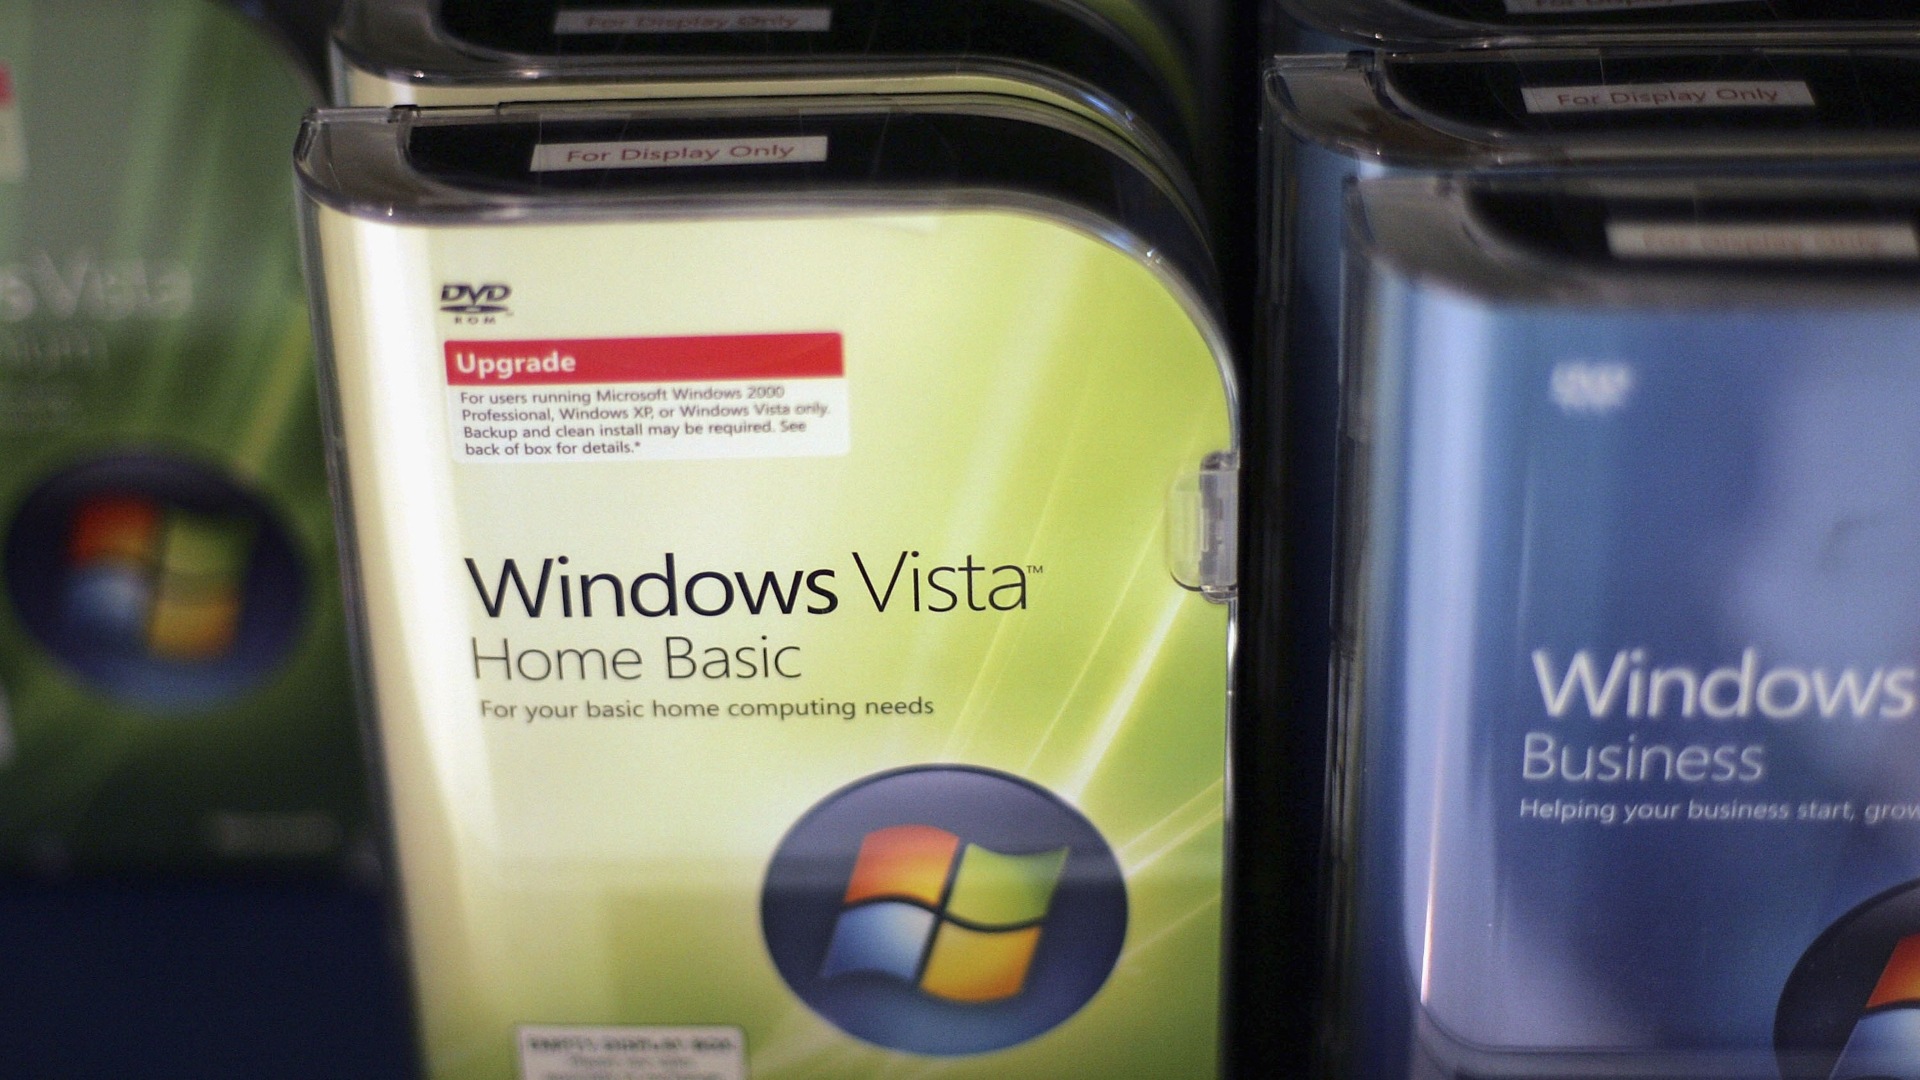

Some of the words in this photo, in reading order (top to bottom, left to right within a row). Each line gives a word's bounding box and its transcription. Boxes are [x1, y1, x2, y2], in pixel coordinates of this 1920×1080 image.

[1557, 93, 1598, 106] For
[1610, 89, 1707, 107] Display
[1716, 87, 1780, 103] Only
[567, 150, 611, 163] For
[621, 146, 721, 165] Display
[729, 144, 796, 161] Only
[441, 284, 511, 304] DVD
[456, 351, 576, 379] Upgrade
[460, 391, 484, 404] For
[489, 393, 527, 404] users
[532, 391, 591, 405] running
[596, 388, 667, 402] Microsoft
[672, 386, 742, 400] Windows
[748, 385, 785, 398] 2000
[462, 407, 555, 422] Professional,
[560, 406, 628, 420] Windows
[633, 406, 654, 420] XP,
[659, 406, 675, 417] or
[680, 403, 749, 417] Windows
[754, 403, 790, 416] Vista
[795, 401, 830, 418] only.
[464, 425, 518, 441] Backup
[523, 425, 550, 438] and
[556, 424, 595, 438] clean
[600, 423, 643, 436] install
[648, 425, 679, 438] may
[685, 422, 703, 435] be
[709, 420, 776, 436] required.
[781, 420, 807, 433] See
[465, 443, 499, 456] back
[505, 442, 519, 456] of
[524, 442, 551, 455] box
[556, 441, 577, 454] for
[464, 552, 839, 618] Windows
[471, 635, 643, 682] Home
[665, 634, 801, 681] Basic
[1531, 647, 1918, 719] Windows
[480, 700, 517, 719] For
[526, 703, 578, 723] your
[587, 699, 644, 719] basic
[652, 699, 719, 718] home
[728, 697, 856, 720] computing
[865, 696, 934, 716] needs
[1522, 732, 1765, 782] Business
[1520, 799, 1615, 824] Helping
[1623, 804, 1680, 824] your
[1688, 799, 1788, 820] business
[1798, 801, 1855, 822] start,
